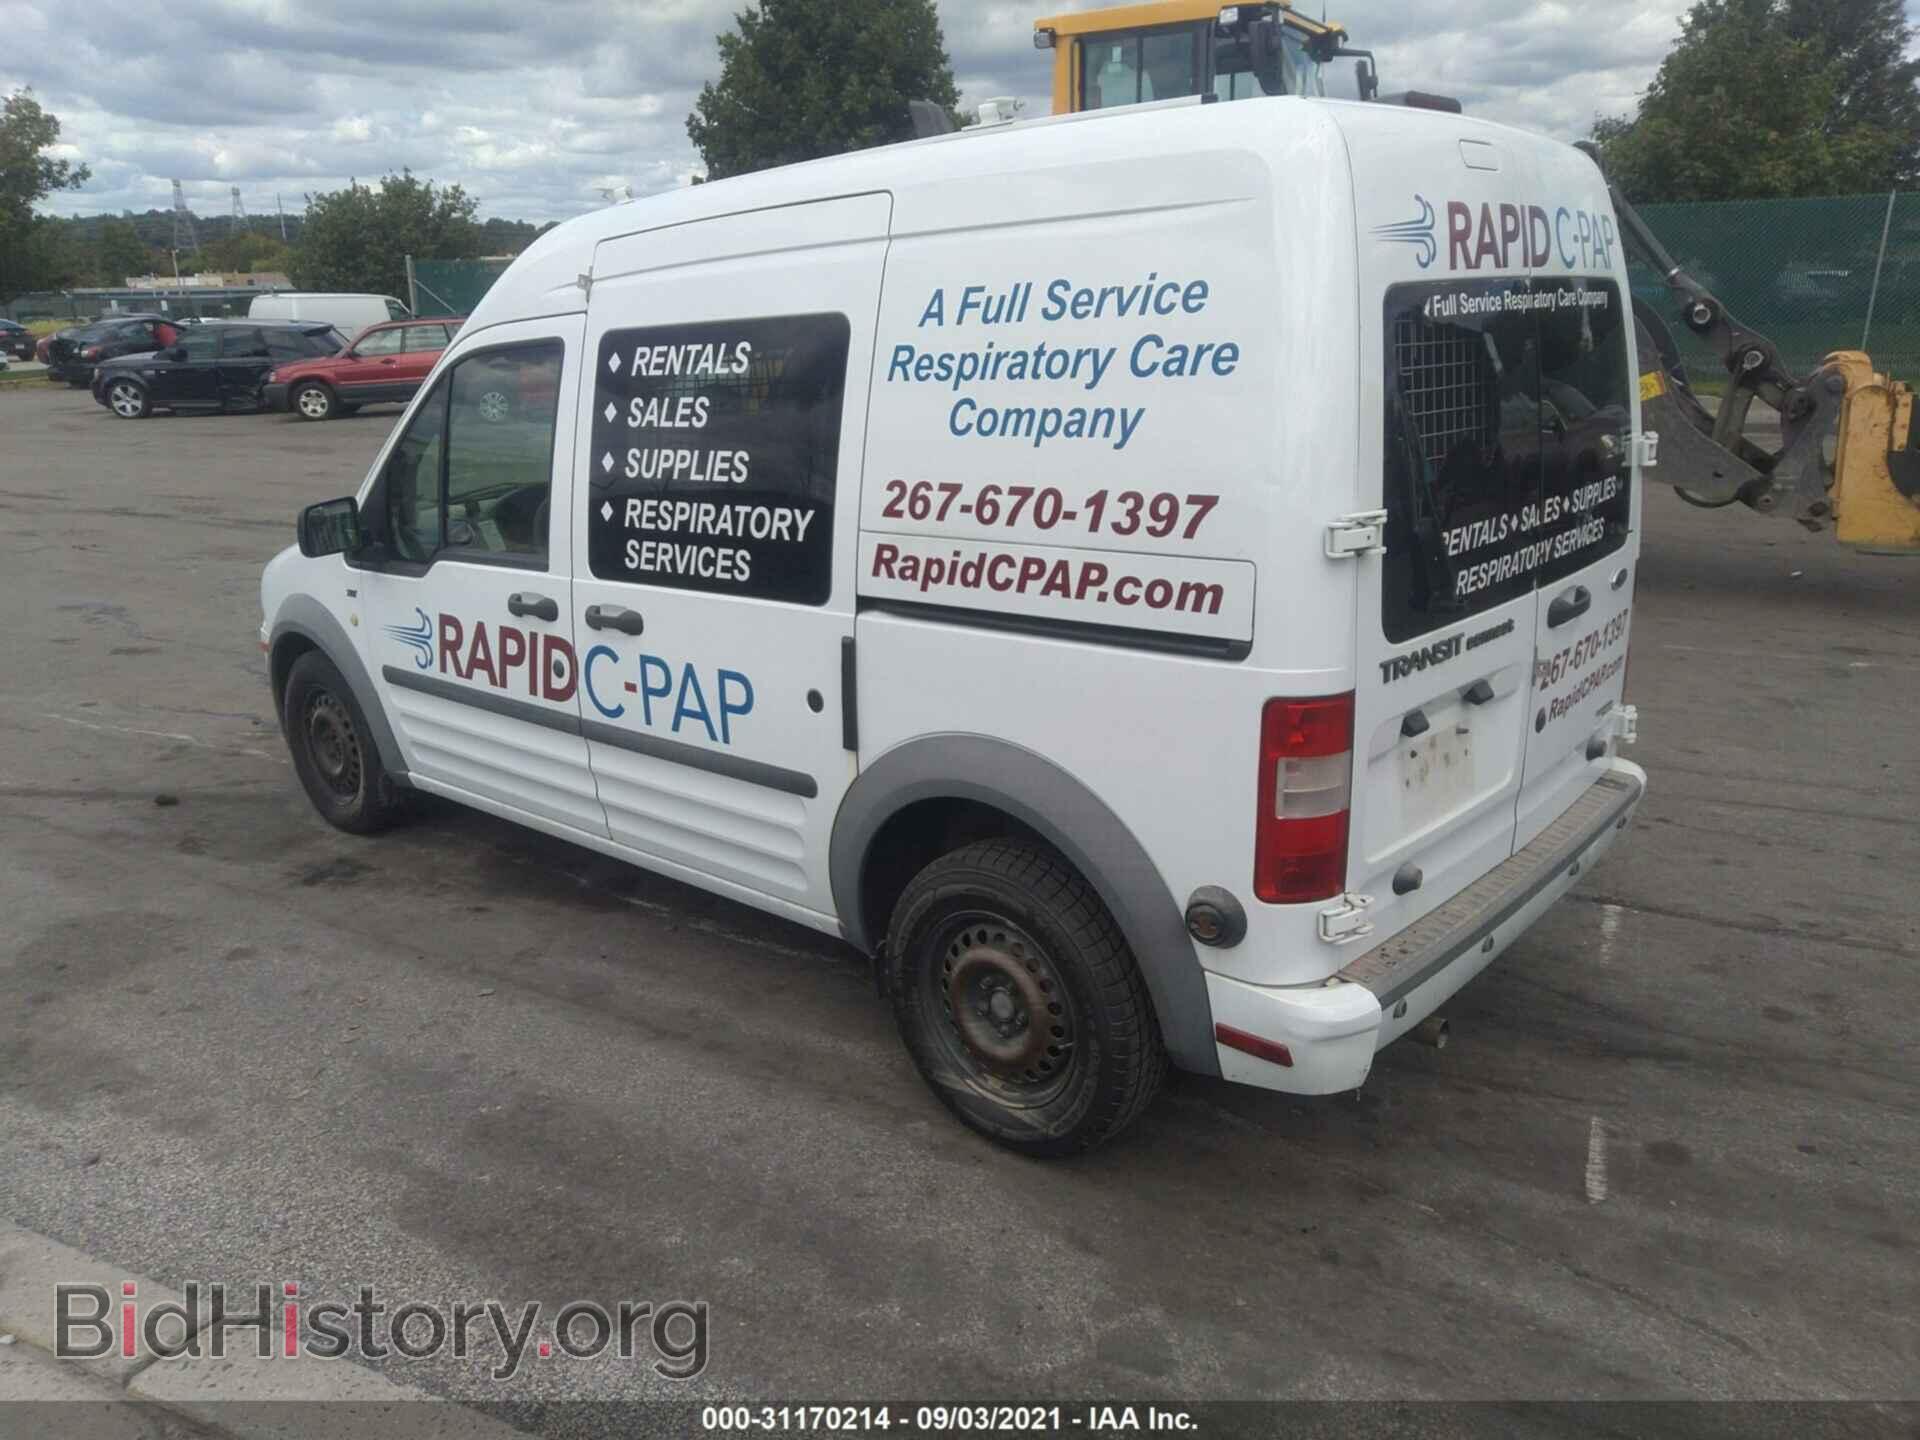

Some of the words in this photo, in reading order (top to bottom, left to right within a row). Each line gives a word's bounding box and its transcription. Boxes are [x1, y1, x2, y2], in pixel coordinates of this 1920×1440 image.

[1447, 201, 1551, 270] RAPID
[1556, 206, 1614, 270] C-PAP
[919, 288, 944, 327] A
[956, 282, 1032, 326] Full
[1041, 272, 1209, 321] Service
[1434, 294, 1457, 317] Full
[1460, 291, 1501, 314] Service
[1558, 288, 1576, 307] Care
[631, 341, 752, 376] RENTALS
[887, 341, 1116, 391] Respiratory
[1130, 334, 1239, 378] Care
[627, 397, 710, 428] SALES
[949, 397, 1145, 450] Company
[624, 448, 750, 483] SUPPLIES
[882, 480, 1219, 539] 267-670-1397
[1571, 476, 1617, 513] SUPPLIES
[624, 499, 815, 543] RESPIRATORY
[624, 539, 751, 582] SERVICES
[872, 543, 1225, 614] RapidCPAP.com
[438, 613, 579, 702] RAPID
[584, 645, 754, 745] C-PAP
[1380, 632, 1465, 684] TRANSIT
